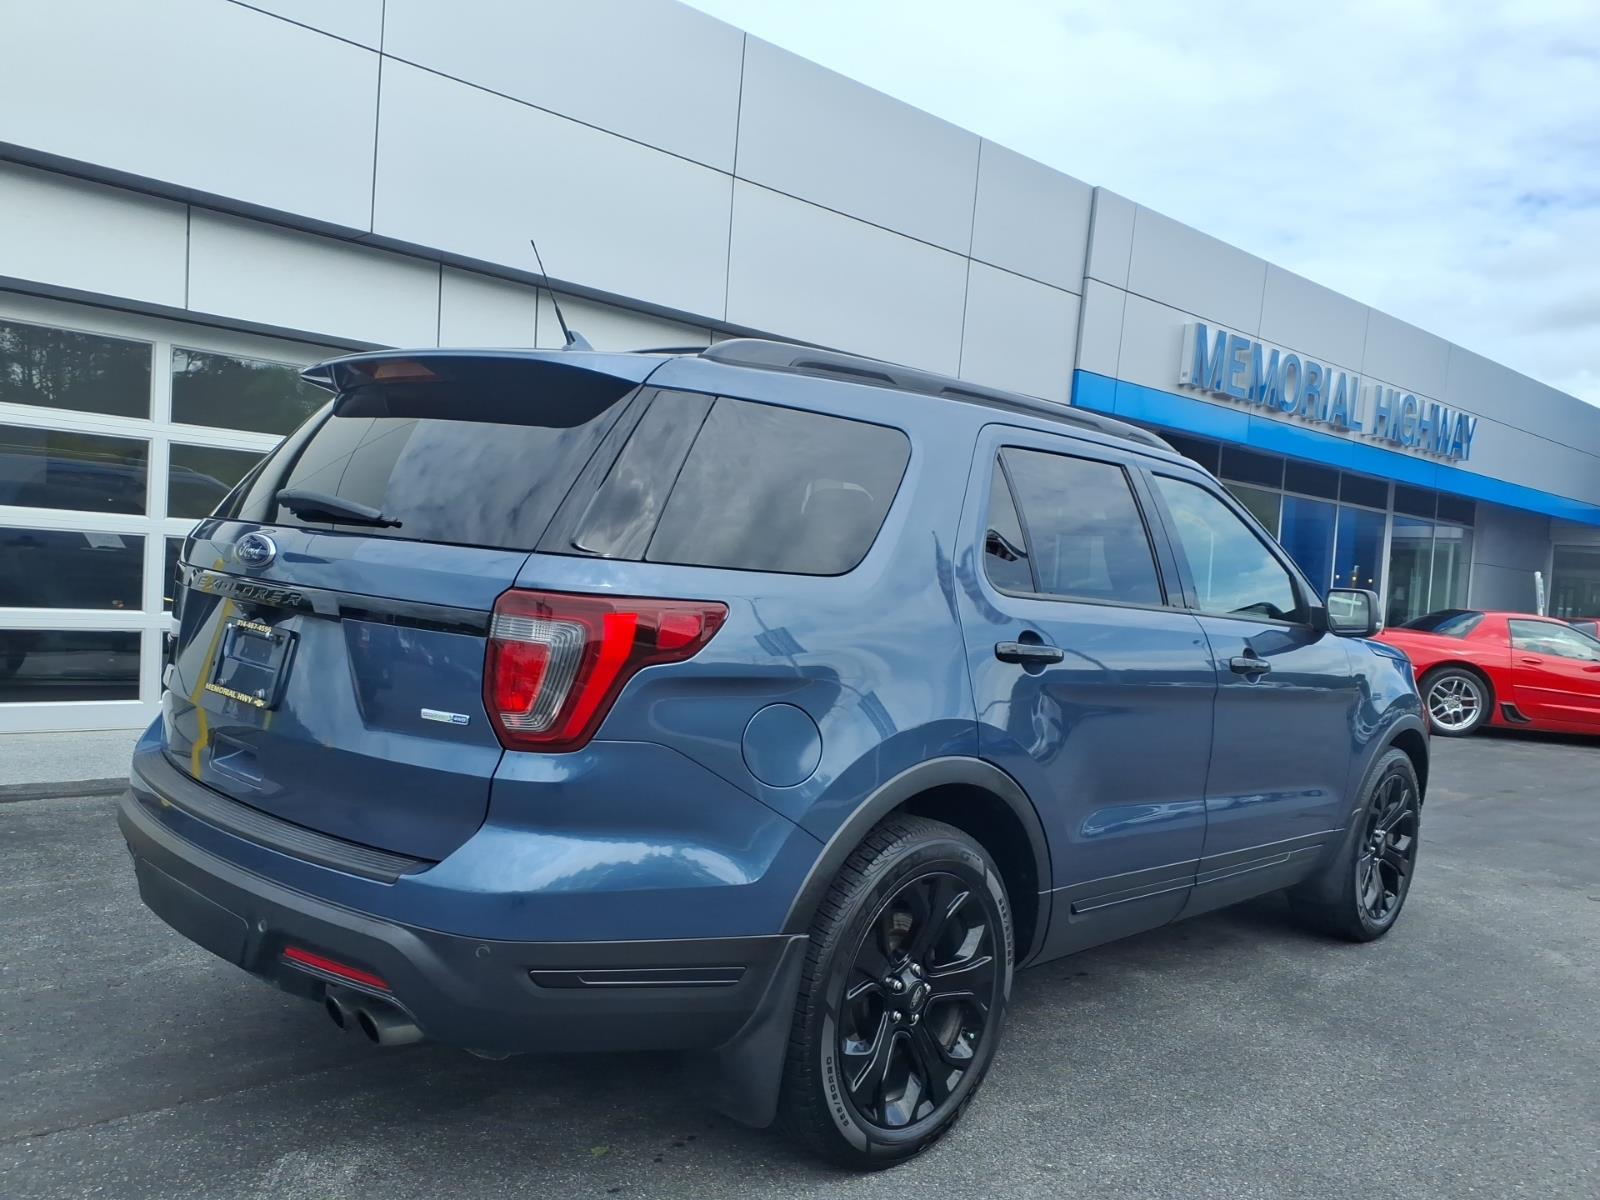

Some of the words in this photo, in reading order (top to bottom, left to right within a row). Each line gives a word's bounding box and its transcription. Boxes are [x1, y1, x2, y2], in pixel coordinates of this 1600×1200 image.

[1182, 322, 1363, 432] MEMORIAL
[1366, 384, 1478, 461] HIGHWAY
[199, 573, 302, 606] EXPLORER
[205, 683, 236, 698] MEMORIAL
[237, 692, 253, 704] HWY
